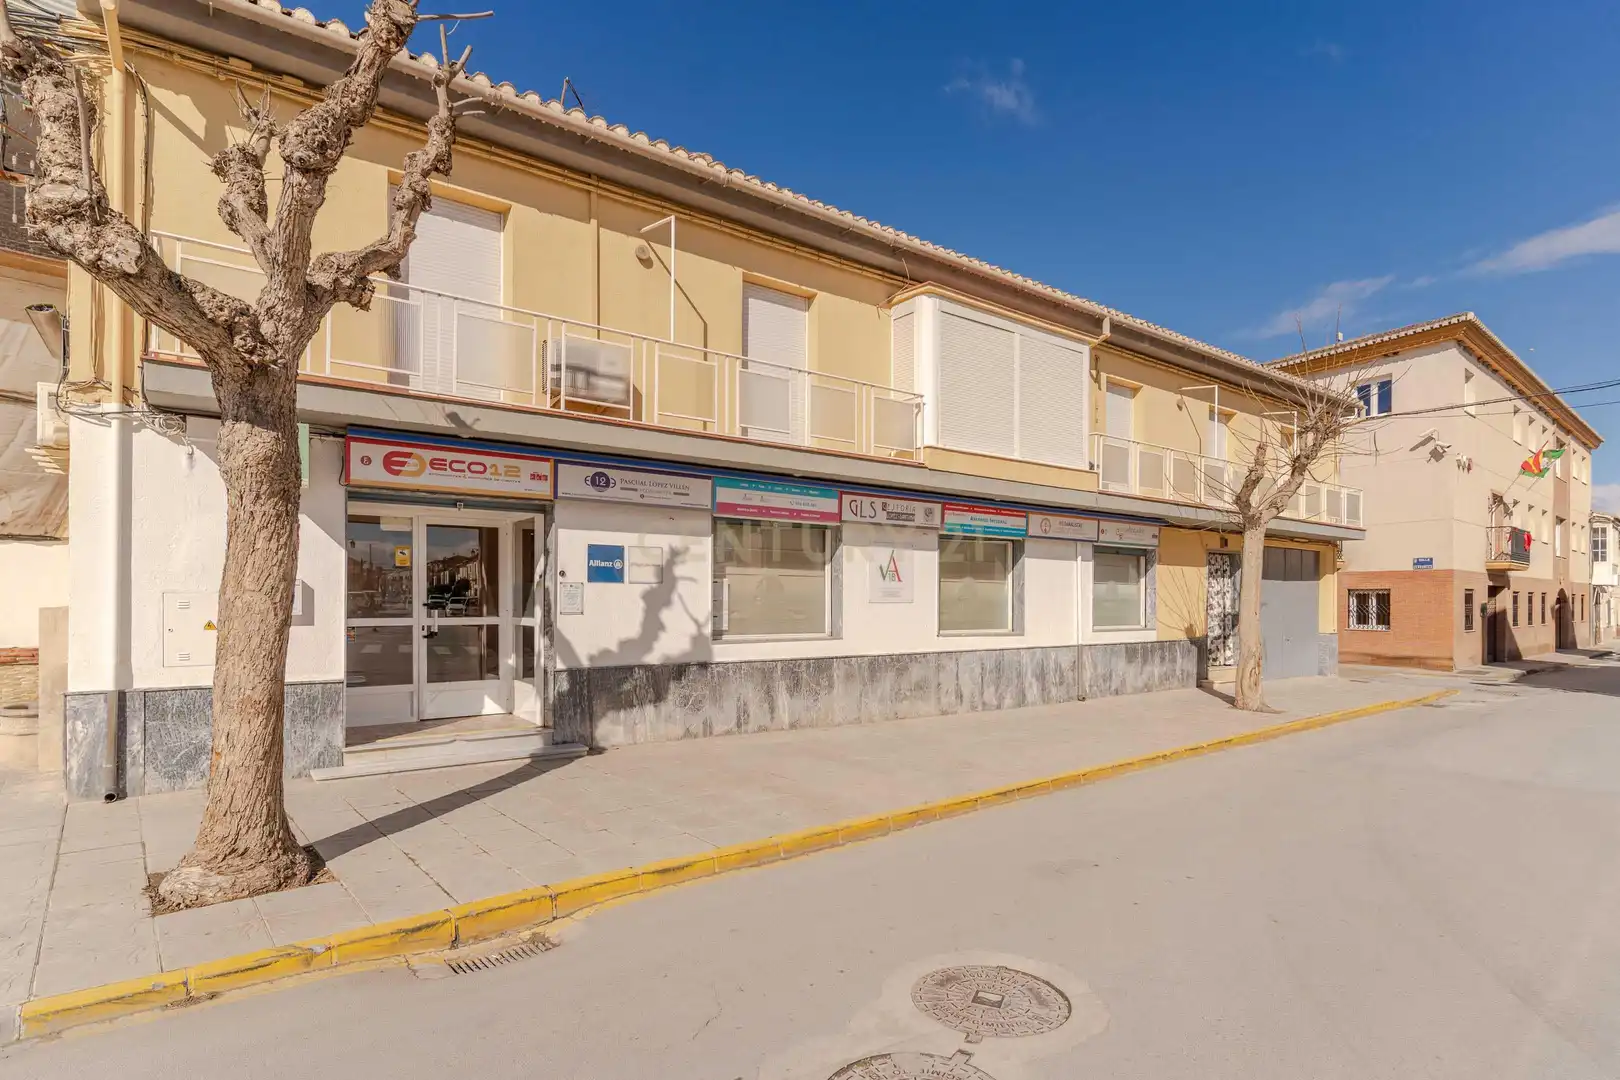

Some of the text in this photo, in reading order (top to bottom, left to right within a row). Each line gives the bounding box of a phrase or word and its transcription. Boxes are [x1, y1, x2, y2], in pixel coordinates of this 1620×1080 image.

[428, 457, 521, 478] ECO12
[595, 476, 606, 486] 12
[620, 478, 648, 487] PASCUAL
[848, 499, 877, 519] GLS
[588, 559, 613, 568] Allianz
